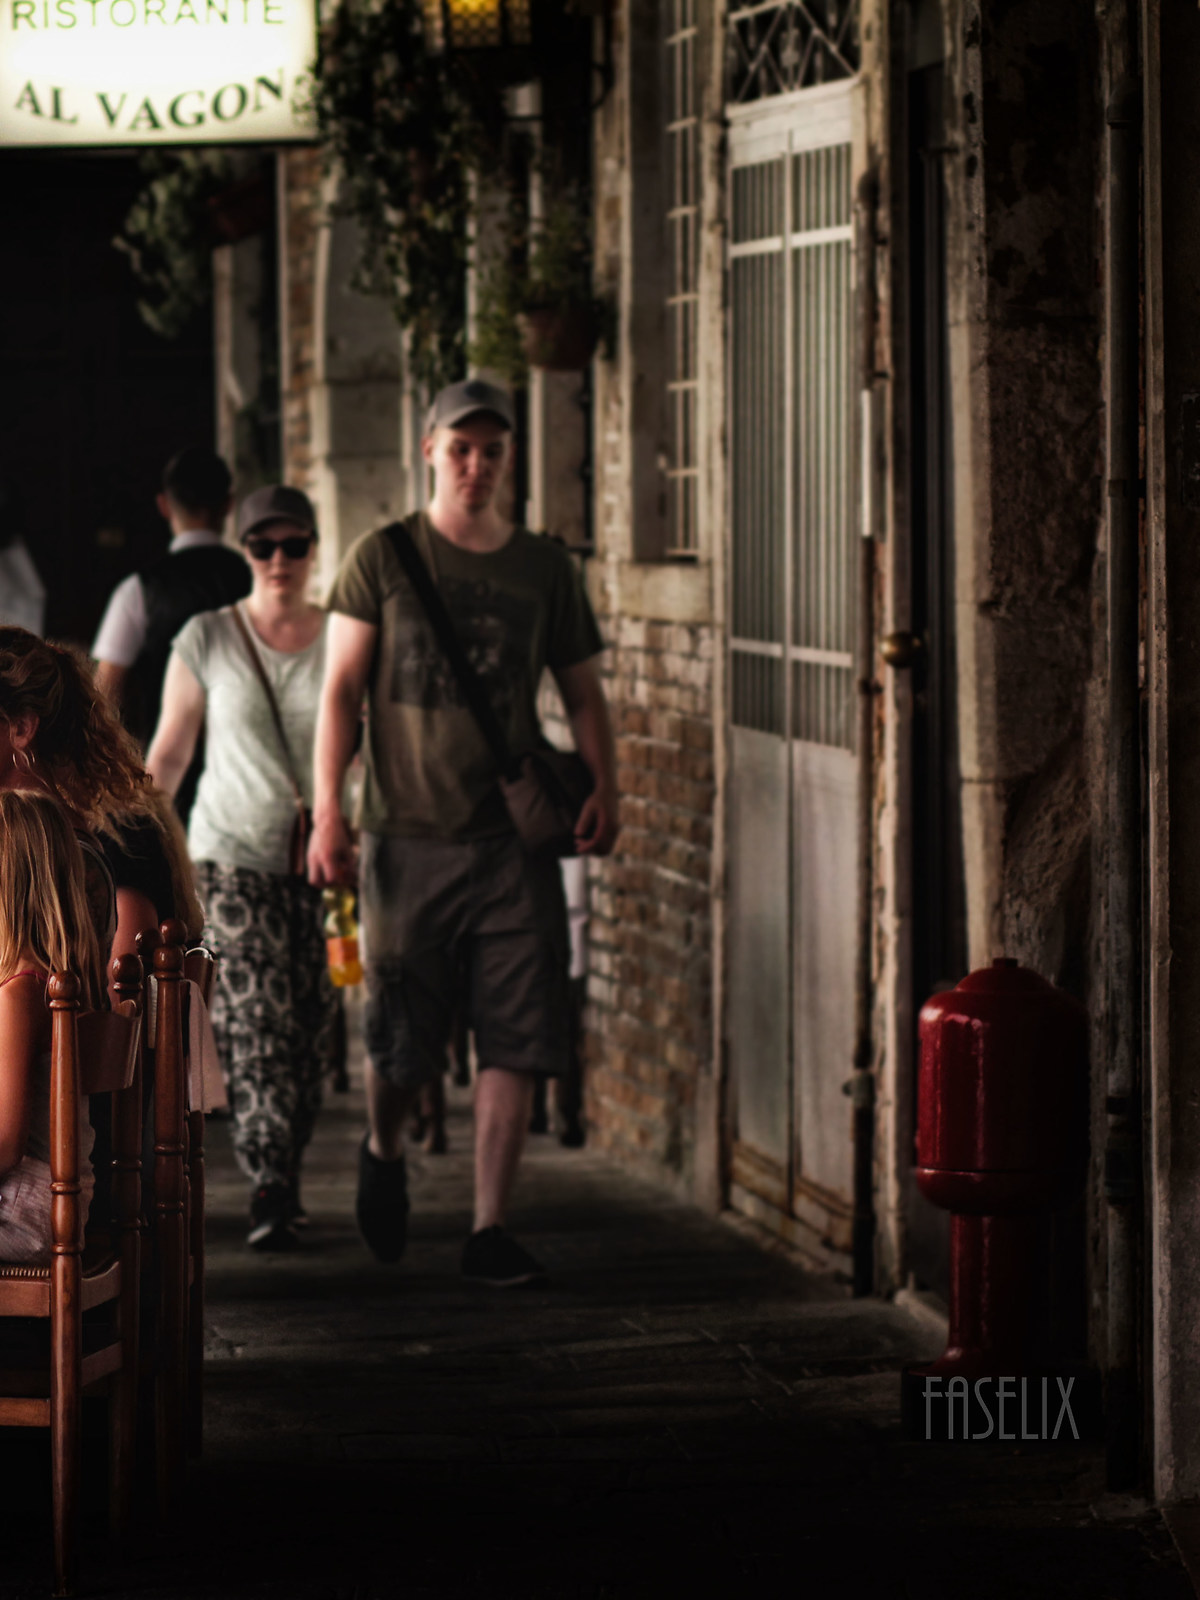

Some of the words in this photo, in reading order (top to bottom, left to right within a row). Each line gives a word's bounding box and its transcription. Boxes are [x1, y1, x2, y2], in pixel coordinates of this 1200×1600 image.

[11, 0, 285, 30] RISTORANTE
[14, 80, 79, 125] AL
[96, 68, 285, 131] VAGON
